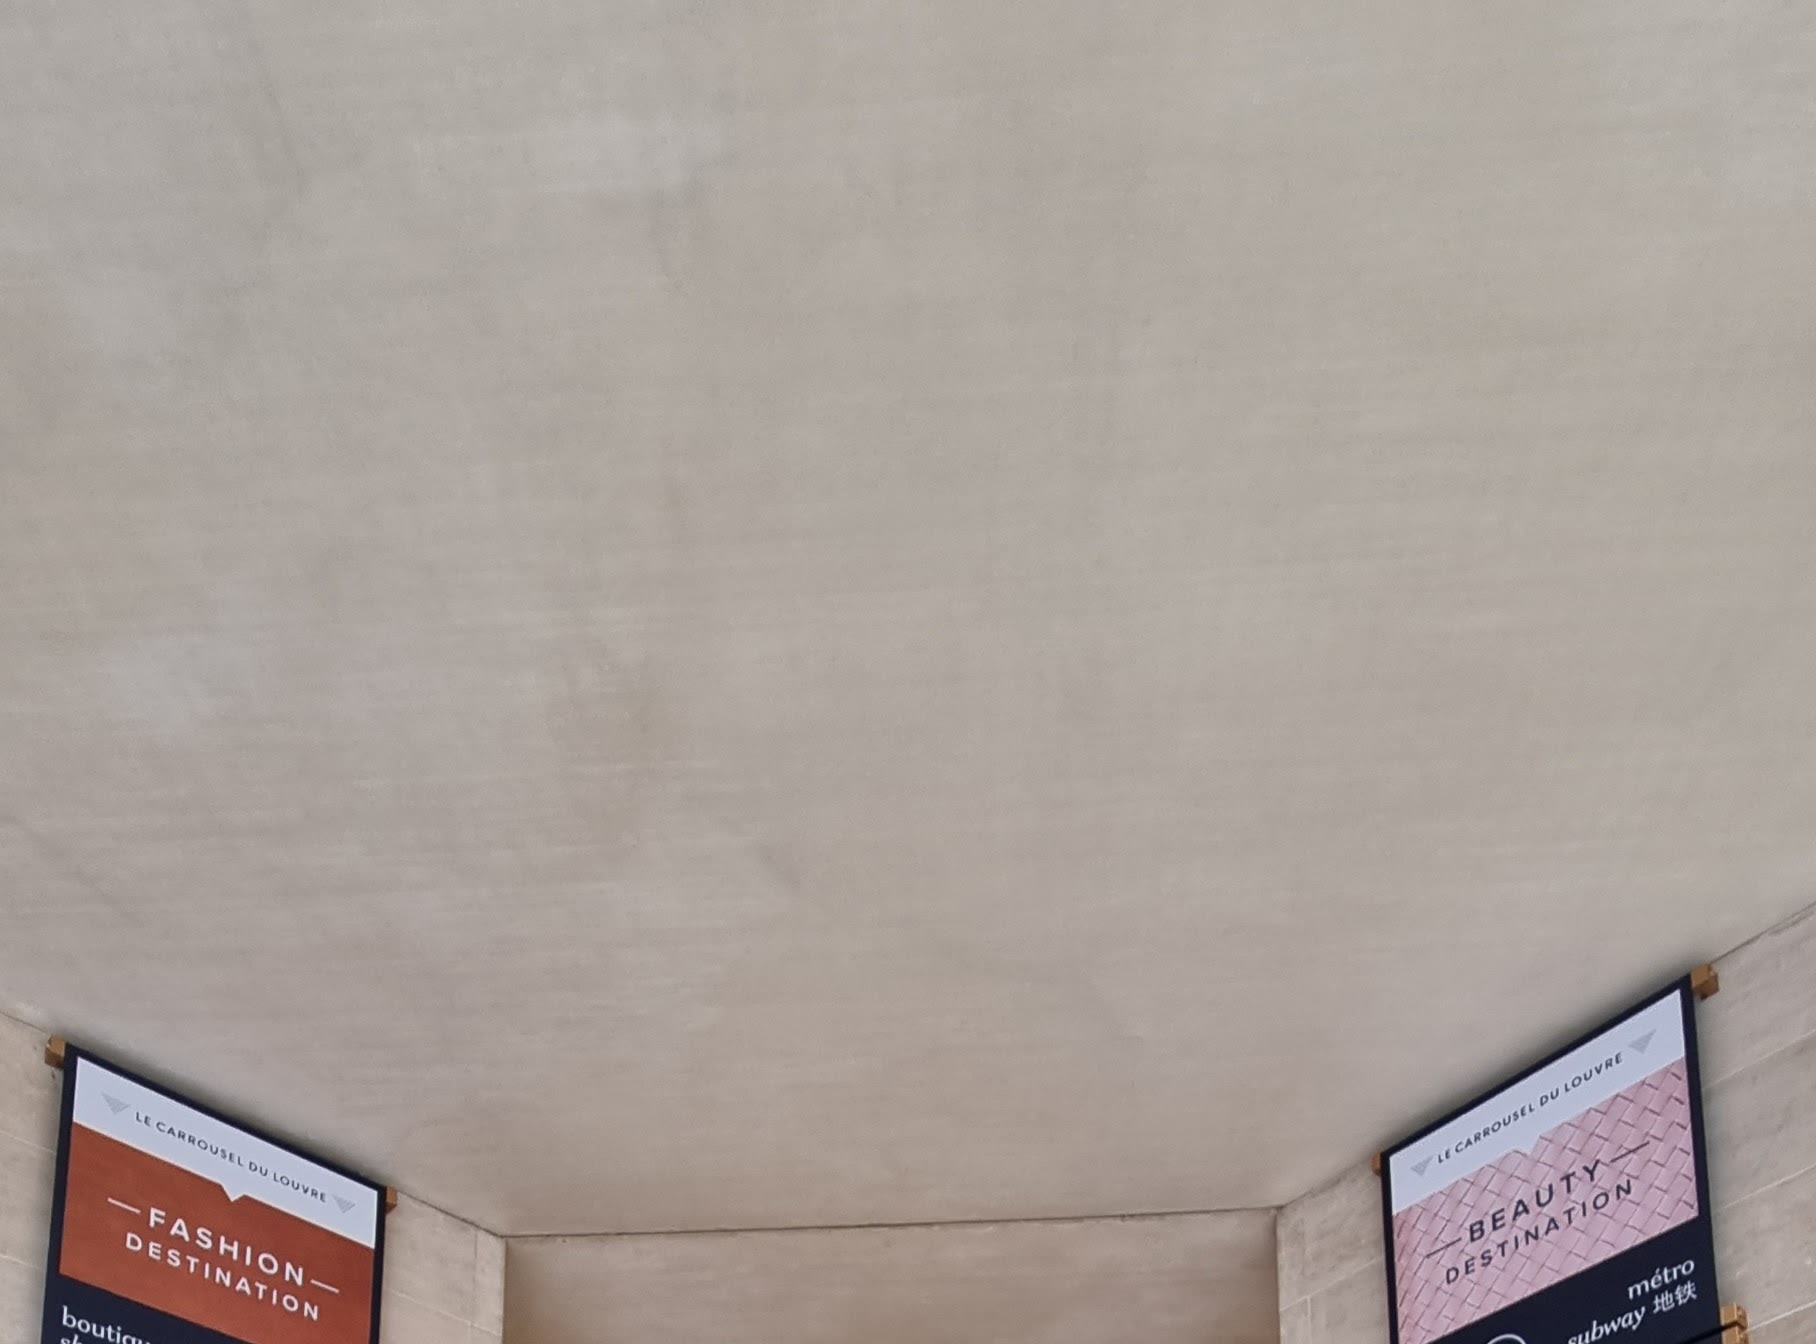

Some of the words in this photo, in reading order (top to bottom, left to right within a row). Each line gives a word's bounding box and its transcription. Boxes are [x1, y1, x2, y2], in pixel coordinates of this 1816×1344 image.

[1437, 1149, 1452, 1164] LE
[1454, 1103, 1536, 1154] CARROUSEL
[1539, 1086, 1559, 1107] DU
[1564, 1052, 1623, 1093] LOUVRE
[135, 1111, 152, 1127] LE
[156, 1121, 244, 1167] CARROUSEL
[249, 1160, 268, 1178] DU
[273, 1171, 327, 1203] LOUVRE
[1446, 1179, 1633, 1285] DESTINATION
[1468, 1159, 1600, 1244] BEAUTY
[125, 1232, 319, 1322] DESTINATION
[148, 1207, 304, 1286] FASHION
[1628, 1258, 1695, 1299] métro
[1653, 1284, 1698, 1316] 地铁
